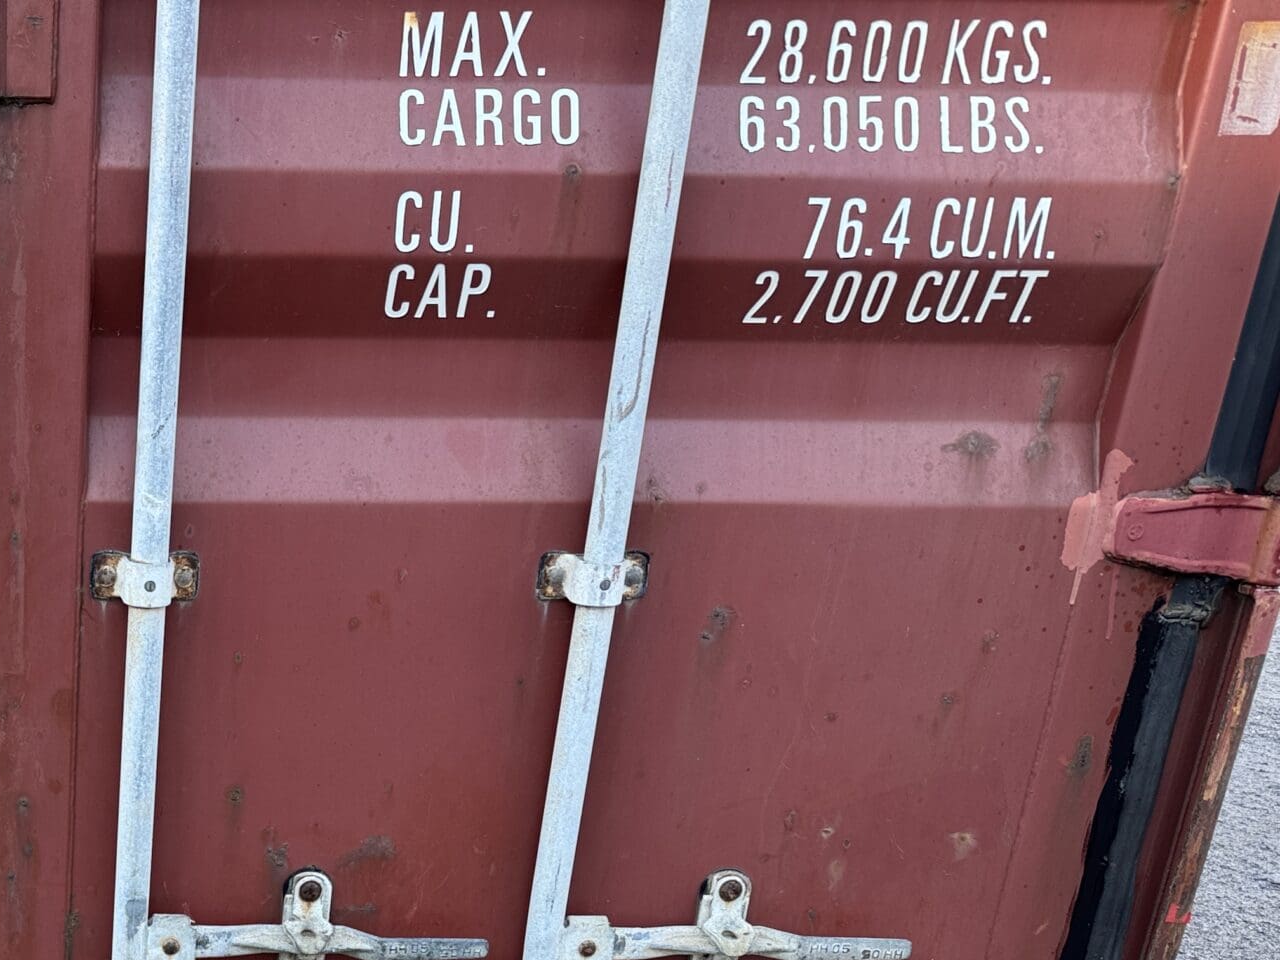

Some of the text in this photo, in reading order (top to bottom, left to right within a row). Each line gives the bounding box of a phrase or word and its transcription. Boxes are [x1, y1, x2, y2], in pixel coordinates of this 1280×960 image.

[399, 11, 546, 77] MAX.
[940, 19, 1052, 85] KGS.
[399, 88, 580, 146] CARGO
[939, 96, 1044, 153] LBS.
[395, 190, 474, 253] CU.
[803, 197, 1056, 260] 76.4 CU.M.
[384, 263, 495, 318] CAP.
[905, 270, 1050, 324] CU.FT.
